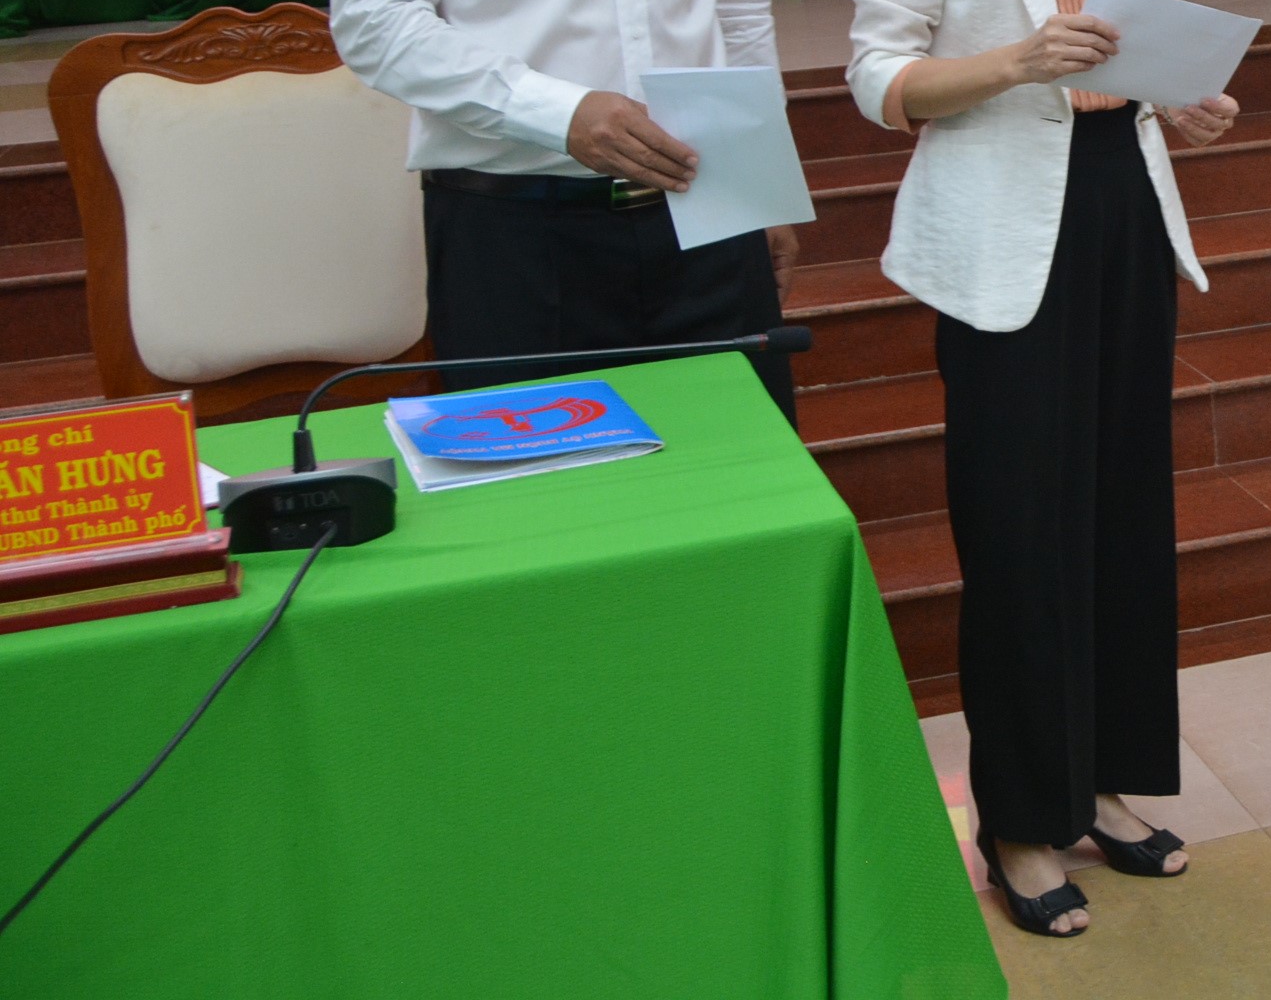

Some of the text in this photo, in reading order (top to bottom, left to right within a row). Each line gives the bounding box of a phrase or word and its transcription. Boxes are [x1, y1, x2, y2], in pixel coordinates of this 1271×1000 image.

[0, 424, 94, 455] ng chí
[56, 449, 166, 491] HƯNG
[0, 488, 153, 525] thư Thành ủy
[66, 515, 139, 540] Thành
[145, 504, 187, 534] phố
